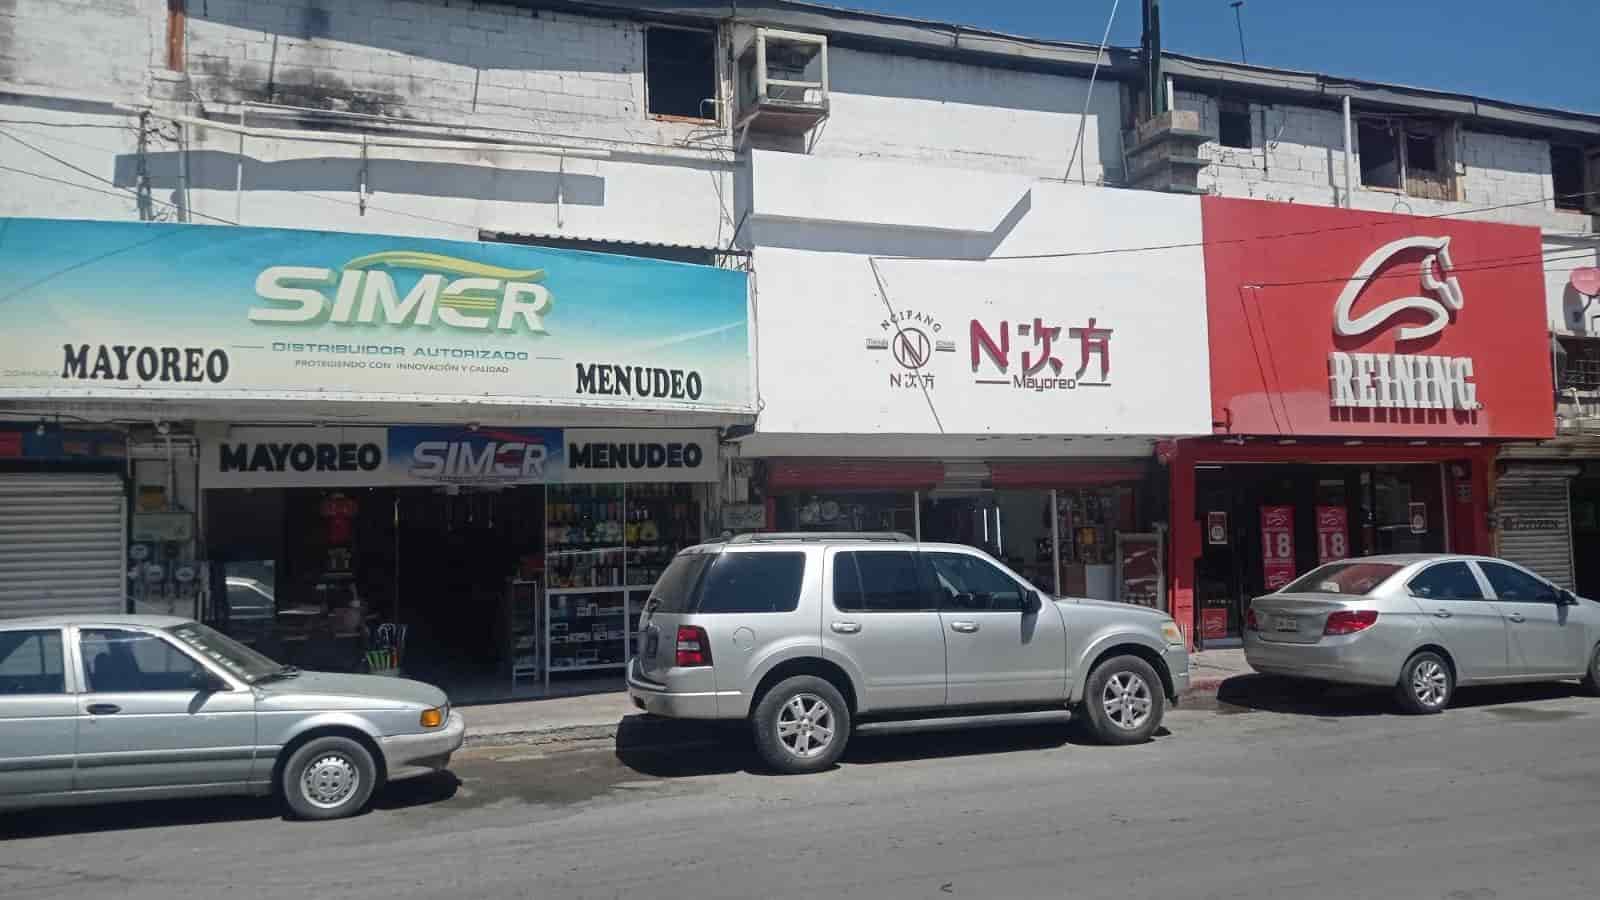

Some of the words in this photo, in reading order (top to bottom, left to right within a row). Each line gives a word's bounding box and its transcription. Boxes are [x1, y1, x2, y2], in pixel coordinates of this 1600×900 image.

[248, 266, 549, 332] SIMER
[62, 344, 228, 382] MAYOREO
[272, 342, 405, 355] DISTRIBUIDOR
[414, 347, 528, 360] AUTORIZADO
[970, 318, 1112, 381] N次方
[295, 360, 366, 369] PROTEGIENDO
[369, 361, 391, 369] CON
[576, 363, 702, 400] MENUDEO
[1013, 375, 1076, 392] Mayoreo
[219, 443, 381, 472] MAYOREO
[410, 441, 546, 478] SIMER
[568, 443, 703, 468] MENUDEO
[1264, 533, 1290, 558] 18
[1319, 533, 1345, 558] 18
